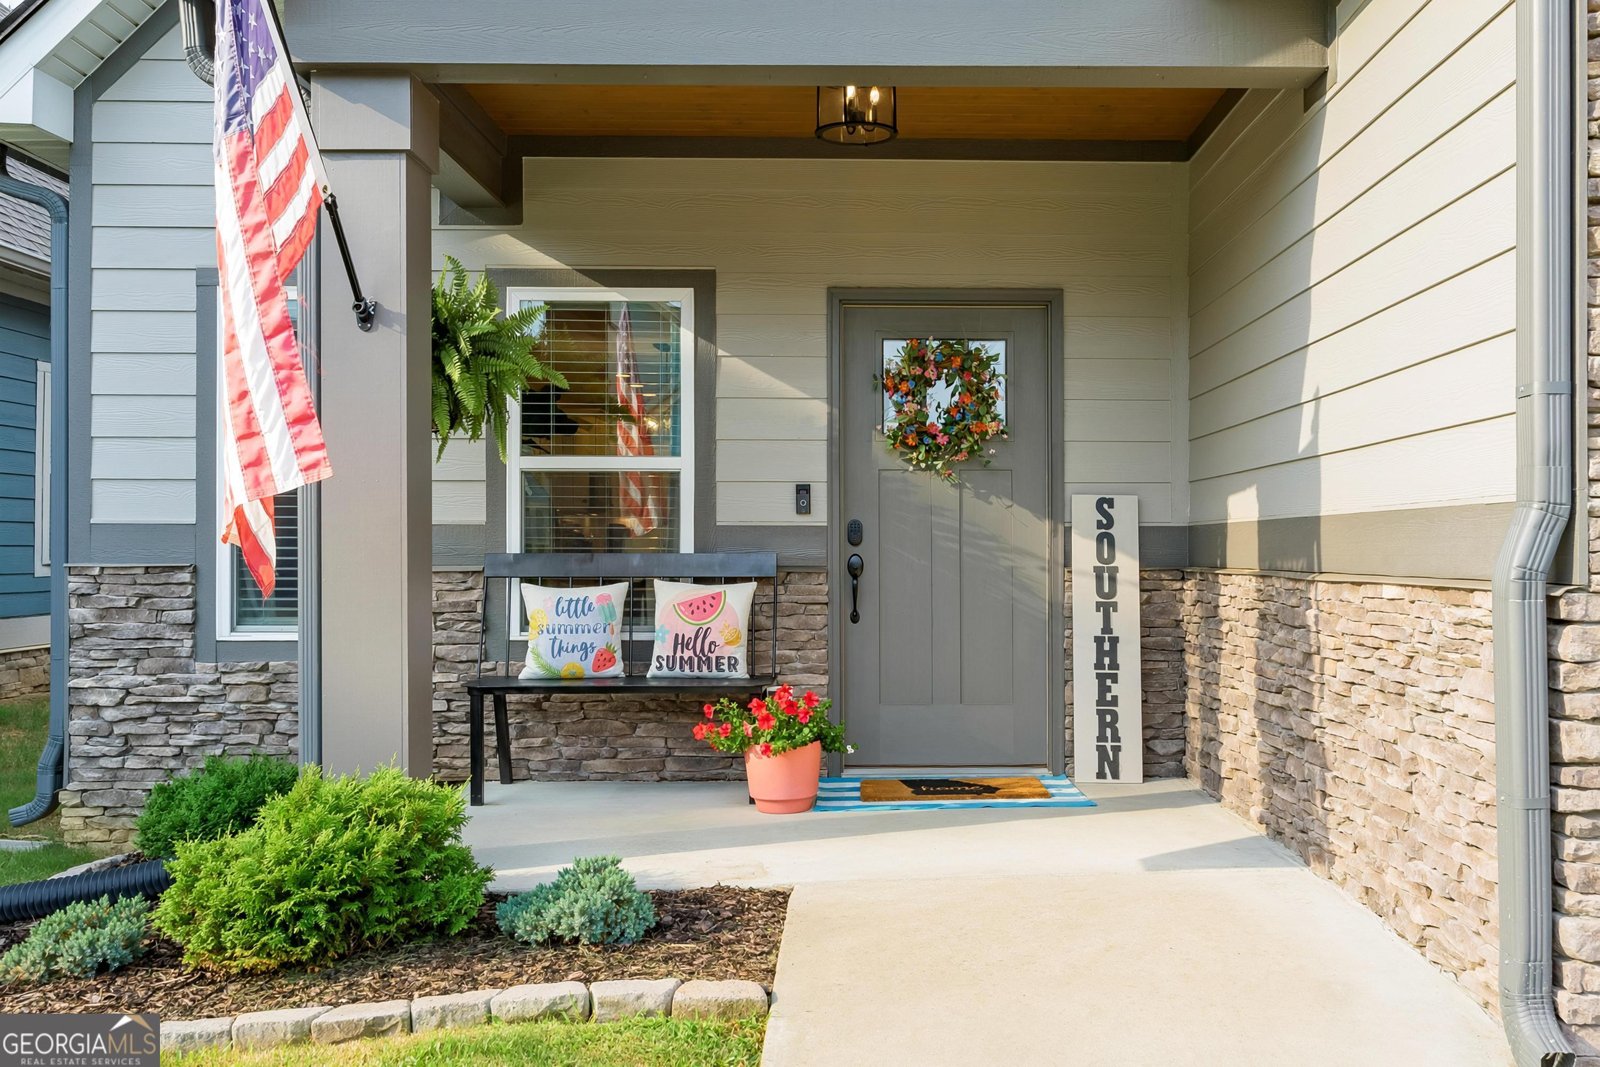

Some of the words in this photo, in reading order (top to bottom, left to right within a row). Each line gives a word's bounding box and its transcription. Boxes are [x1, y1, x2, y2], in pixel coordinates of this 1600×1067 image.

[555, 595, 595, 619] little
[538, 622, 610, 635] summer
[1093, 497, 1121, 779] SOUTHERN
[550, 637, 597, 661] things
[673, 627, 720, 657] Hello
[655, 655, 739, 673] SUMMER
